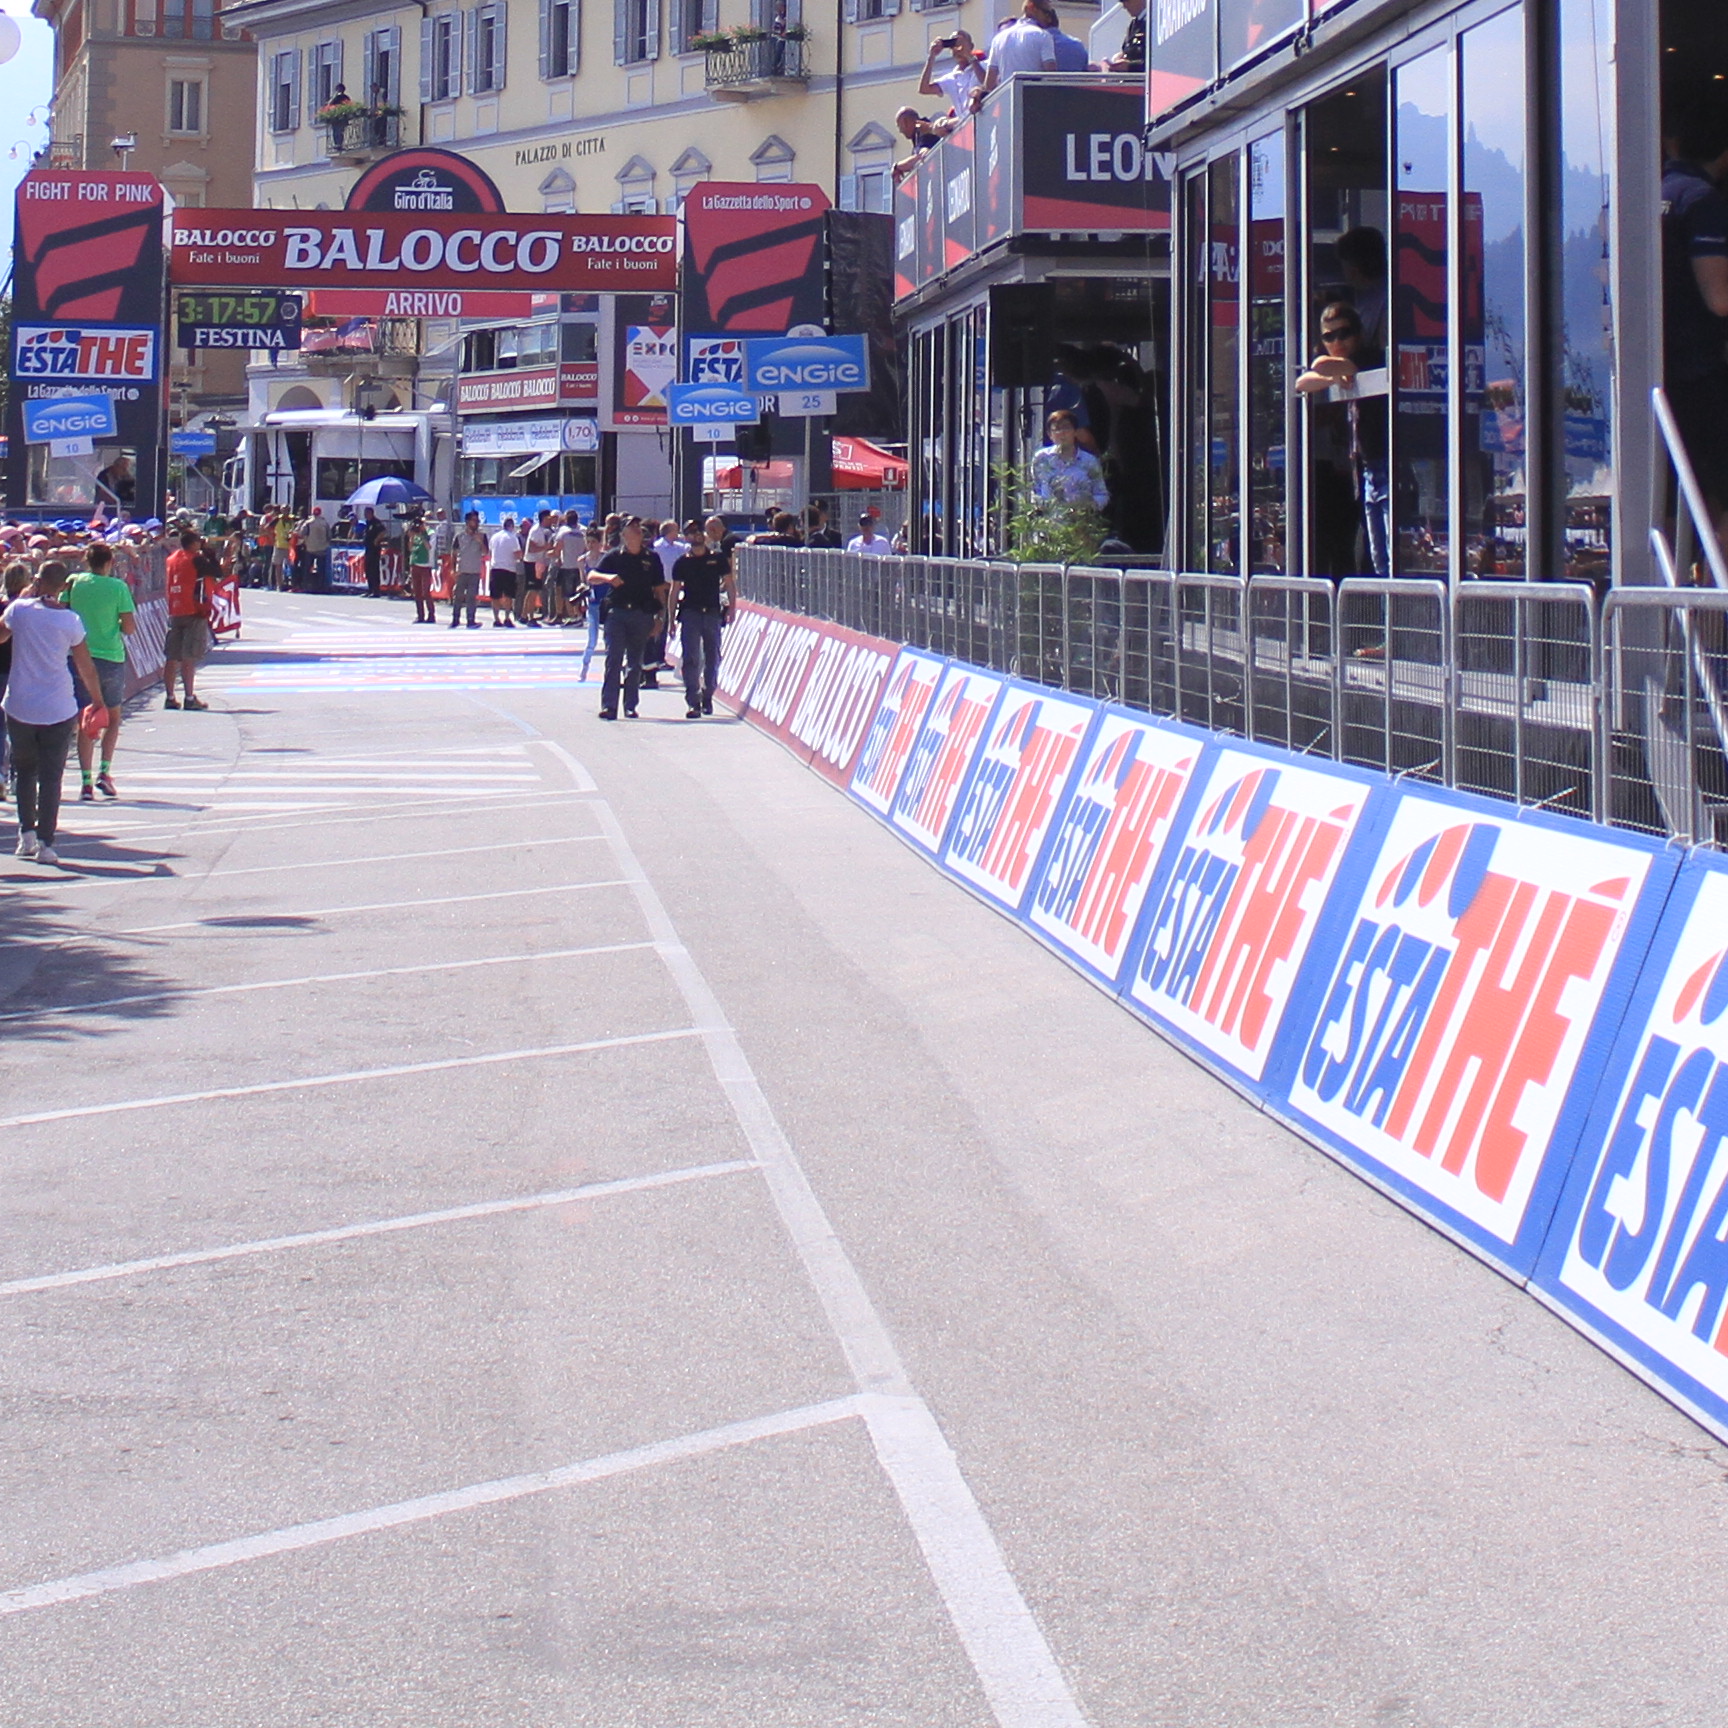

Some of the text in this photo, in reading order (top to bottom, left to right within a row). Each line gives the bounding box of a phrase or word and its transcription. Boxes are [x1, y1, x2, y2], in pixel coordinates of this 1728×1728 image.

[515, 144, 557, 166] PALAZZO
[561, 142, 572, 159] DI
[26, 181, 153, 203] FIGHT FOR PINK
[394, 191, 416, 210] Giro
[174, 229, 277, 247] BALOCCO
[571, 235, 674, 254] BALOCCO
[189, 250, 214, 264] Fate
[225, 250, 261, 265] buoni
[282, 226, 563, 273] BALOCCO
[587, 257, 613, 270] Fate
[623, 257, 658, 270] buoni
[384, 293, 463, 315] ARRIVO
[194, 328, 286, 348] FESTINA
[801, 395, 821, 409] 25
[707, 429, 720, 439] 10
[65, 443, 79, 454] 10
[788, 636, 892, 771] BALOCCO
